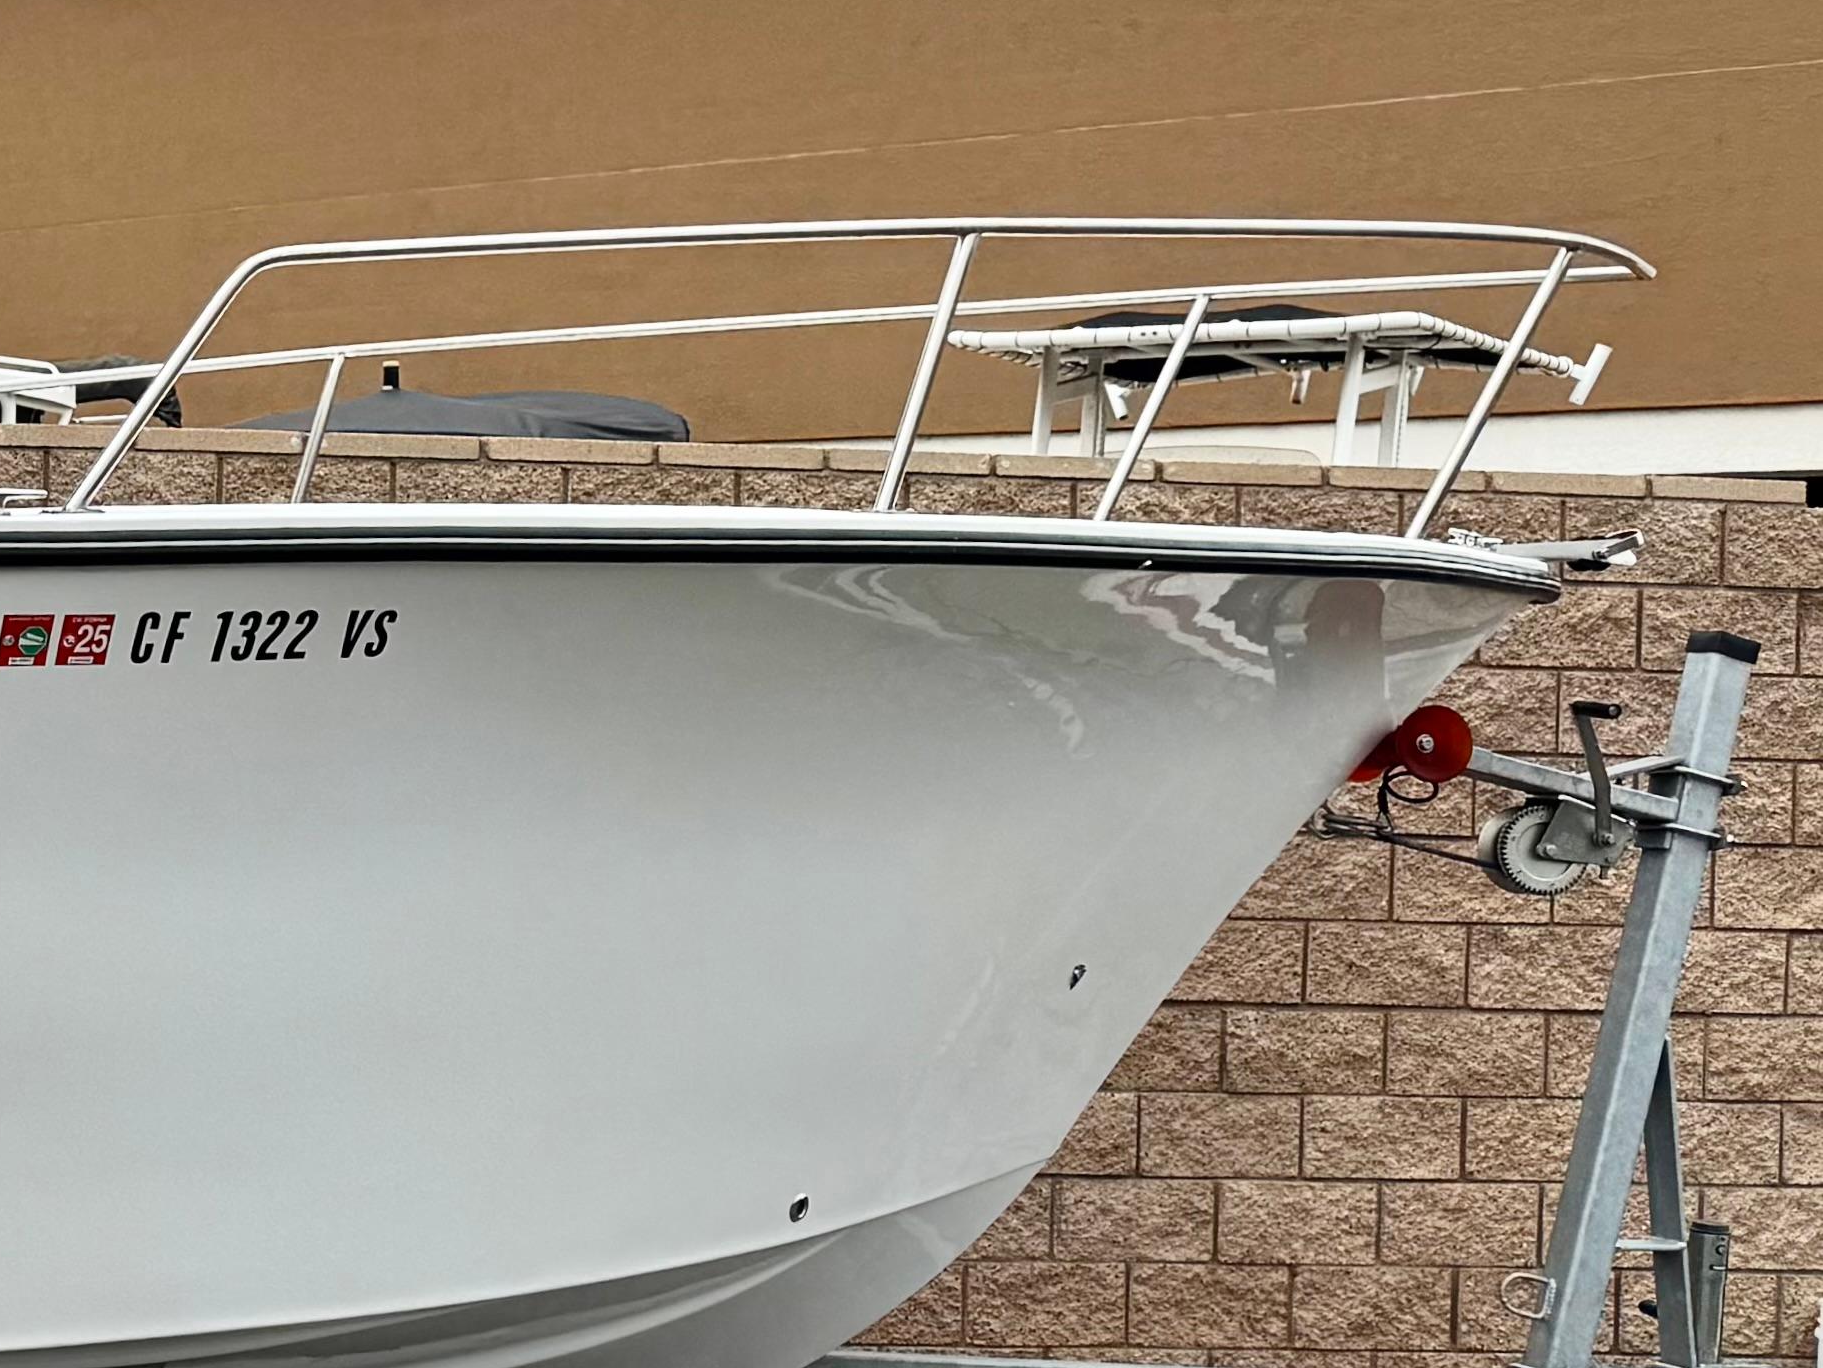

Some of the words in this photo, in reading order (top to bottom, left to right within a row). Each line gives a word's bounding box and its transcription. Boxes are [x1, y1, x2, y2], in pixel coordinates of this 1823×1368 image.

[74, 624, 111, 653] 25
[130, 612, 191, 663] CF
[211, 610, 318, 662] 1322
[340, 609, 398, 658] VS
